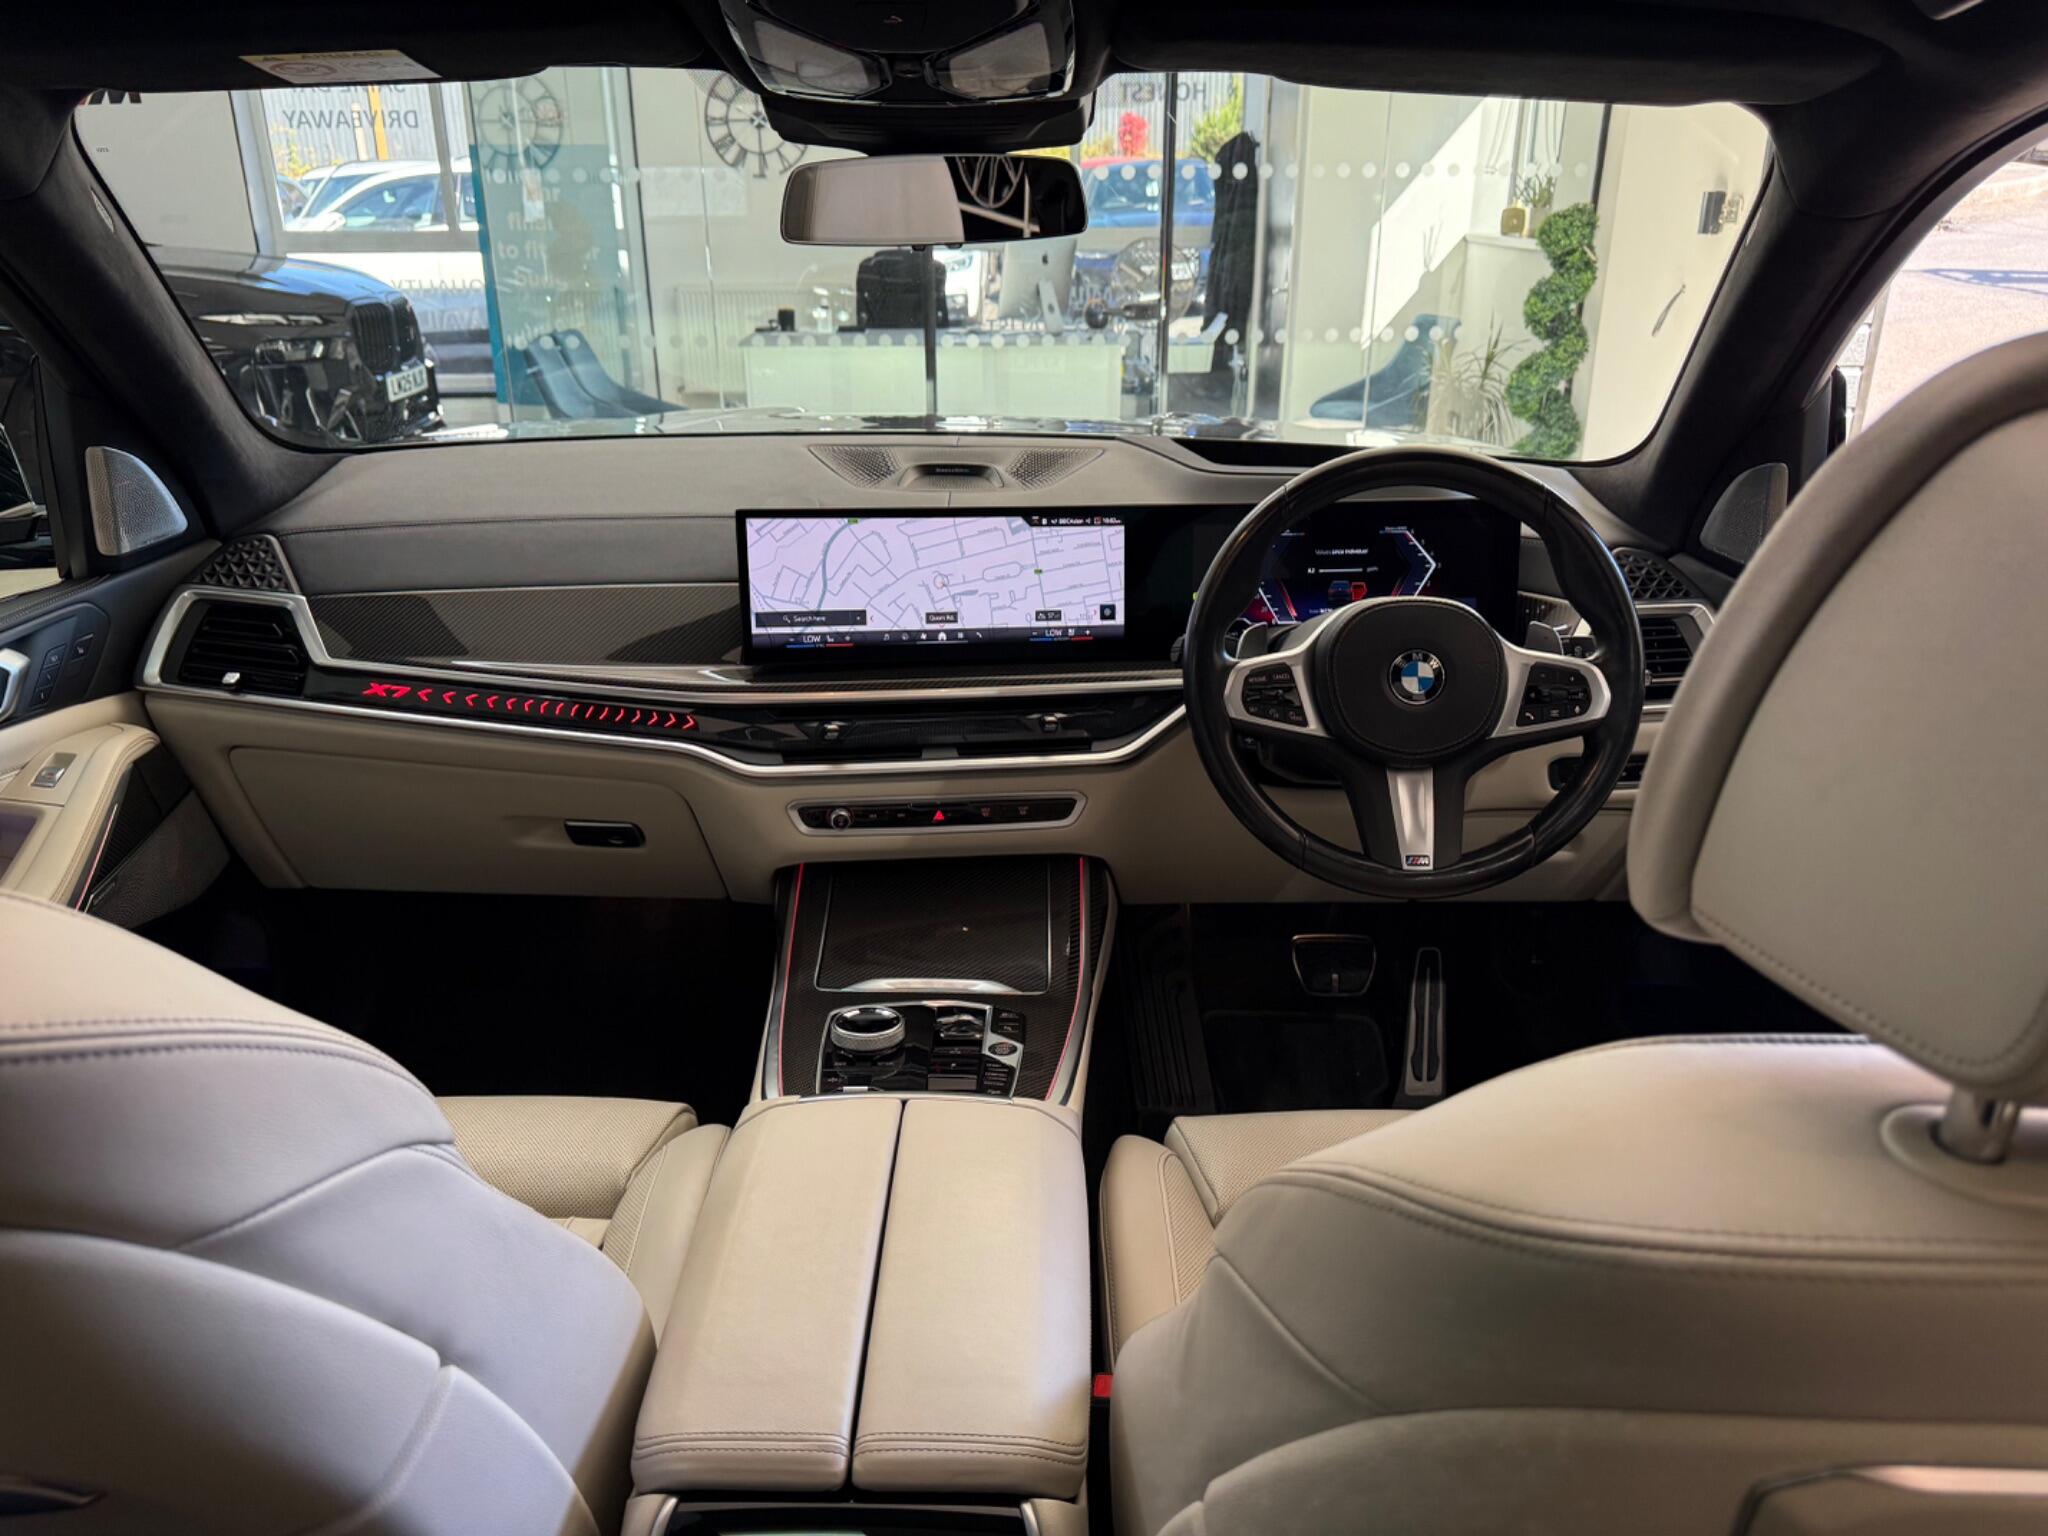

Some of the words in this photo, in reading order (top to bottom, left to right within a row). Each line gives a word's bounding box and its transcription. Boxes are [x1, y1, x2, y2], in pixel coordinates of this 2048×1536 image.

[1045, 629, 1063, 637] LOW
[802, 635, 821, 643] LOW
[362, 682, 412, 699] X7
